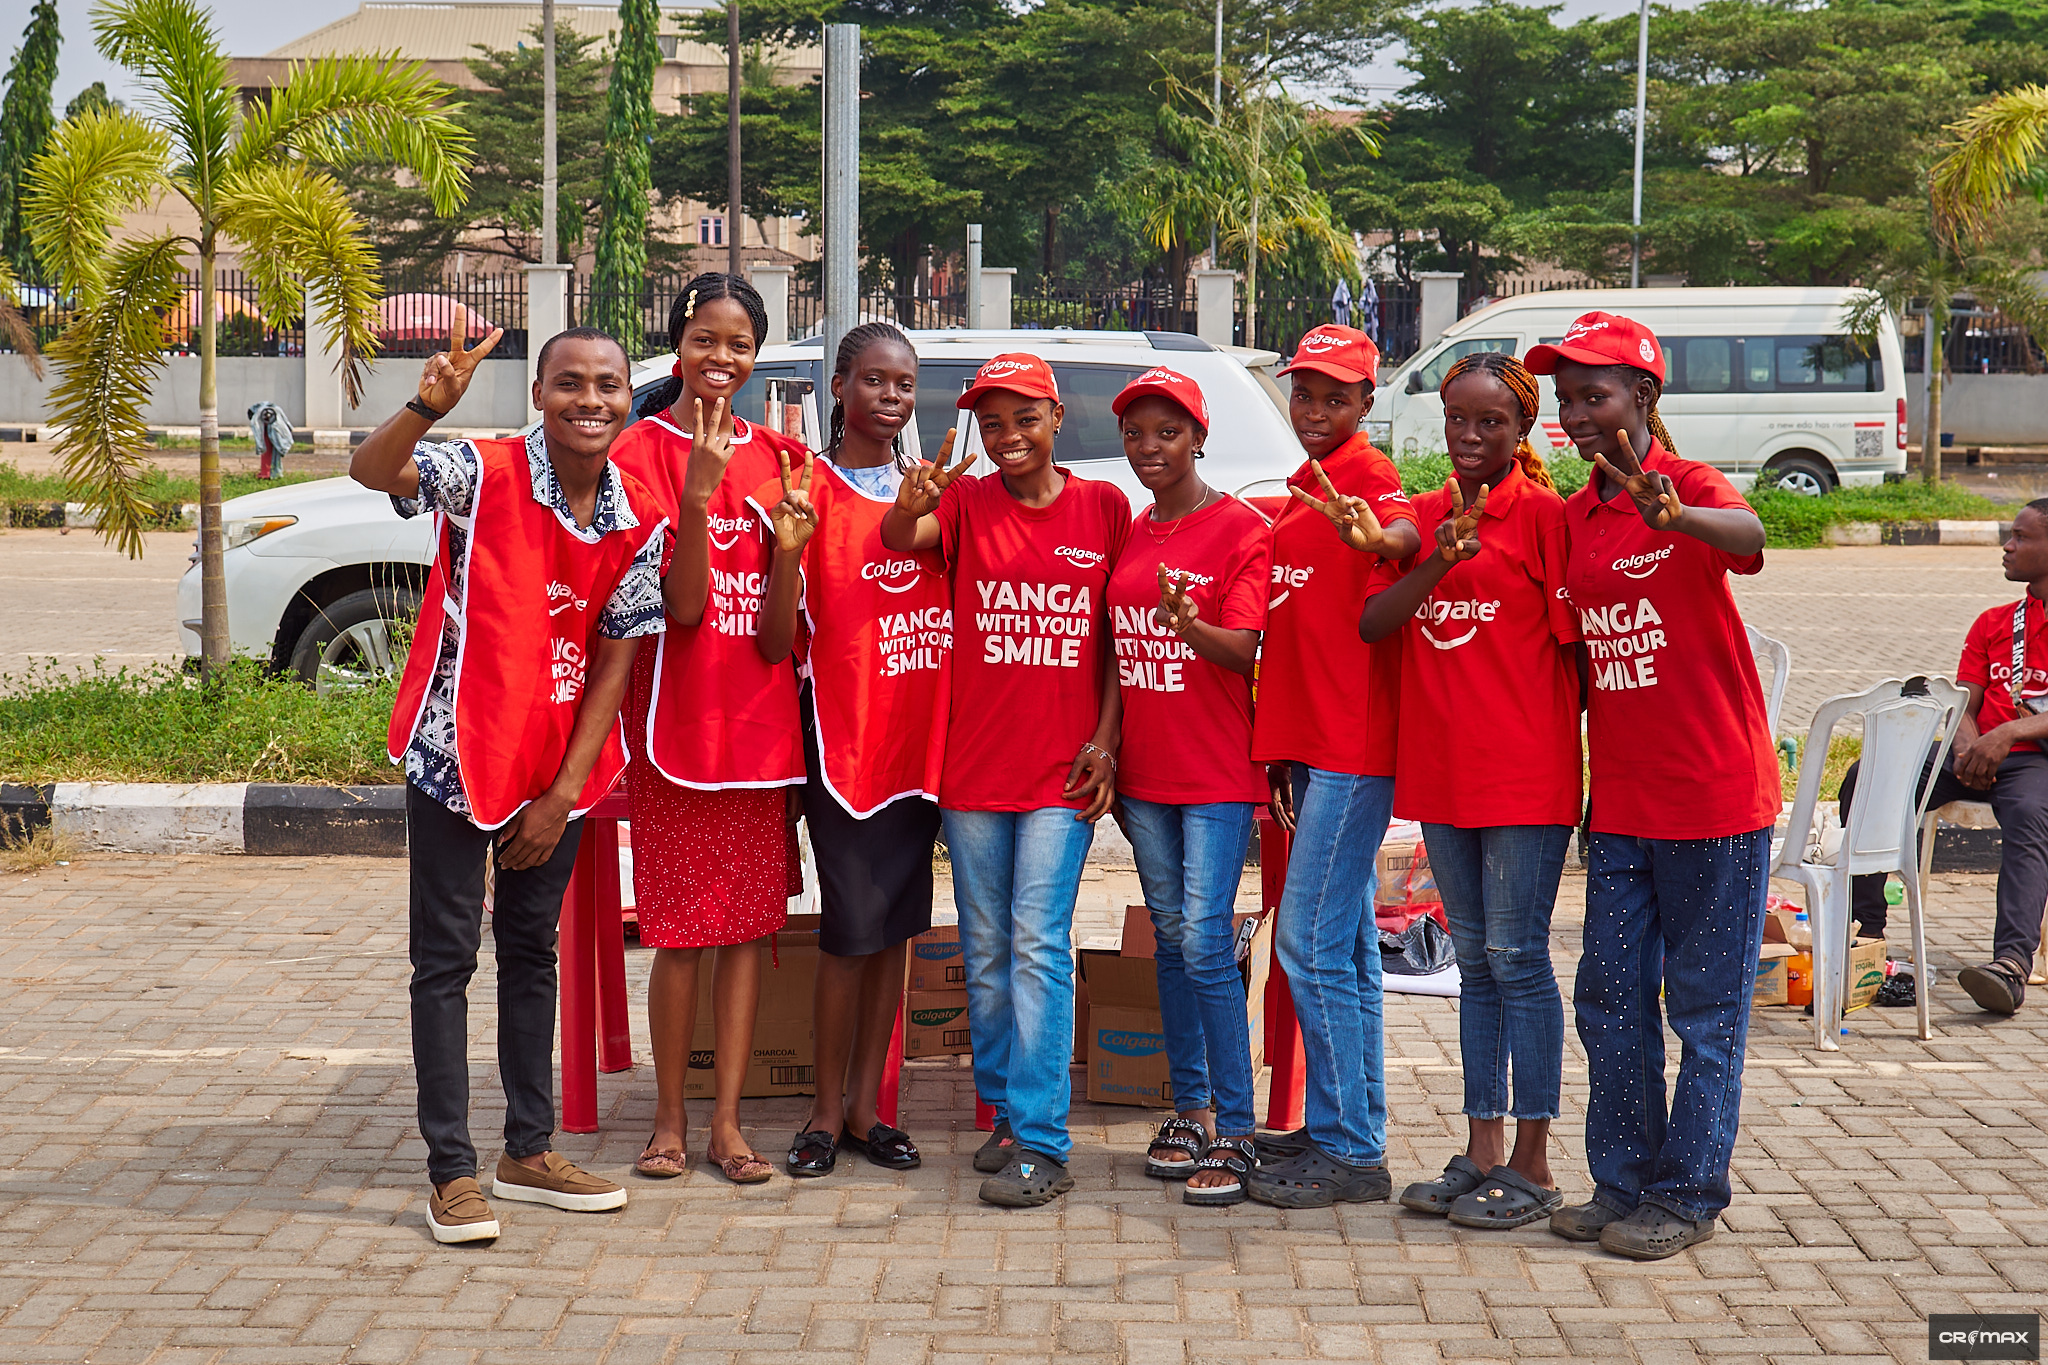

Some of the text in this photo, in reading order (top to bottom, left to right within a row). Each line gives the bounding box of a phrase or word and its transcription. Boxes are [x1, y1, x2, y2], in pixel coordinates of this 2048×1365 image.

[981, 361, 1029, 377] Colgate
[1797, 420, 1813, 429] edo
[1815, 420, 1830, 429] has
[1832, 420, 1852, 429] risen
[707, 513, 753, 534] olgate
[1054, 545, 1103, 564] Colgate
[1612, 548, 1671, 571] Colgate
[976, 580, 1091, 615] YANGA
[878, 606, 954, 638] YANGA
[1108, 605, 1177, 638] ANG
[1414, 595, 1496, 626] olgate
[1578, 597, 1663, 636] ANGA
[2012, 607, 2025, 633] SEE
[718, 610, 758, 637] SMIL
[975, 613, 1090, 637] WITH YOUR
[878, 634, 916, 656] WITH
[983, 634, 1081, 668] SMILE
[1140, 639, 1197, 661] YOUR
[2012, 639, 2025, 672] LOVE
[1119, 659, 1185, 693] SMILE
[1594, 654, 1658, 692] MILE
[917, 944, 962, 957] Colgate
[913, 1010, 956, 1022] Colgate
[1101, 1032, 1165, 1050] Colgate
[753, 1049, 798, 1057] CHARCOAL
[1101, 1083, 1160, 1097] PROMO PACK
